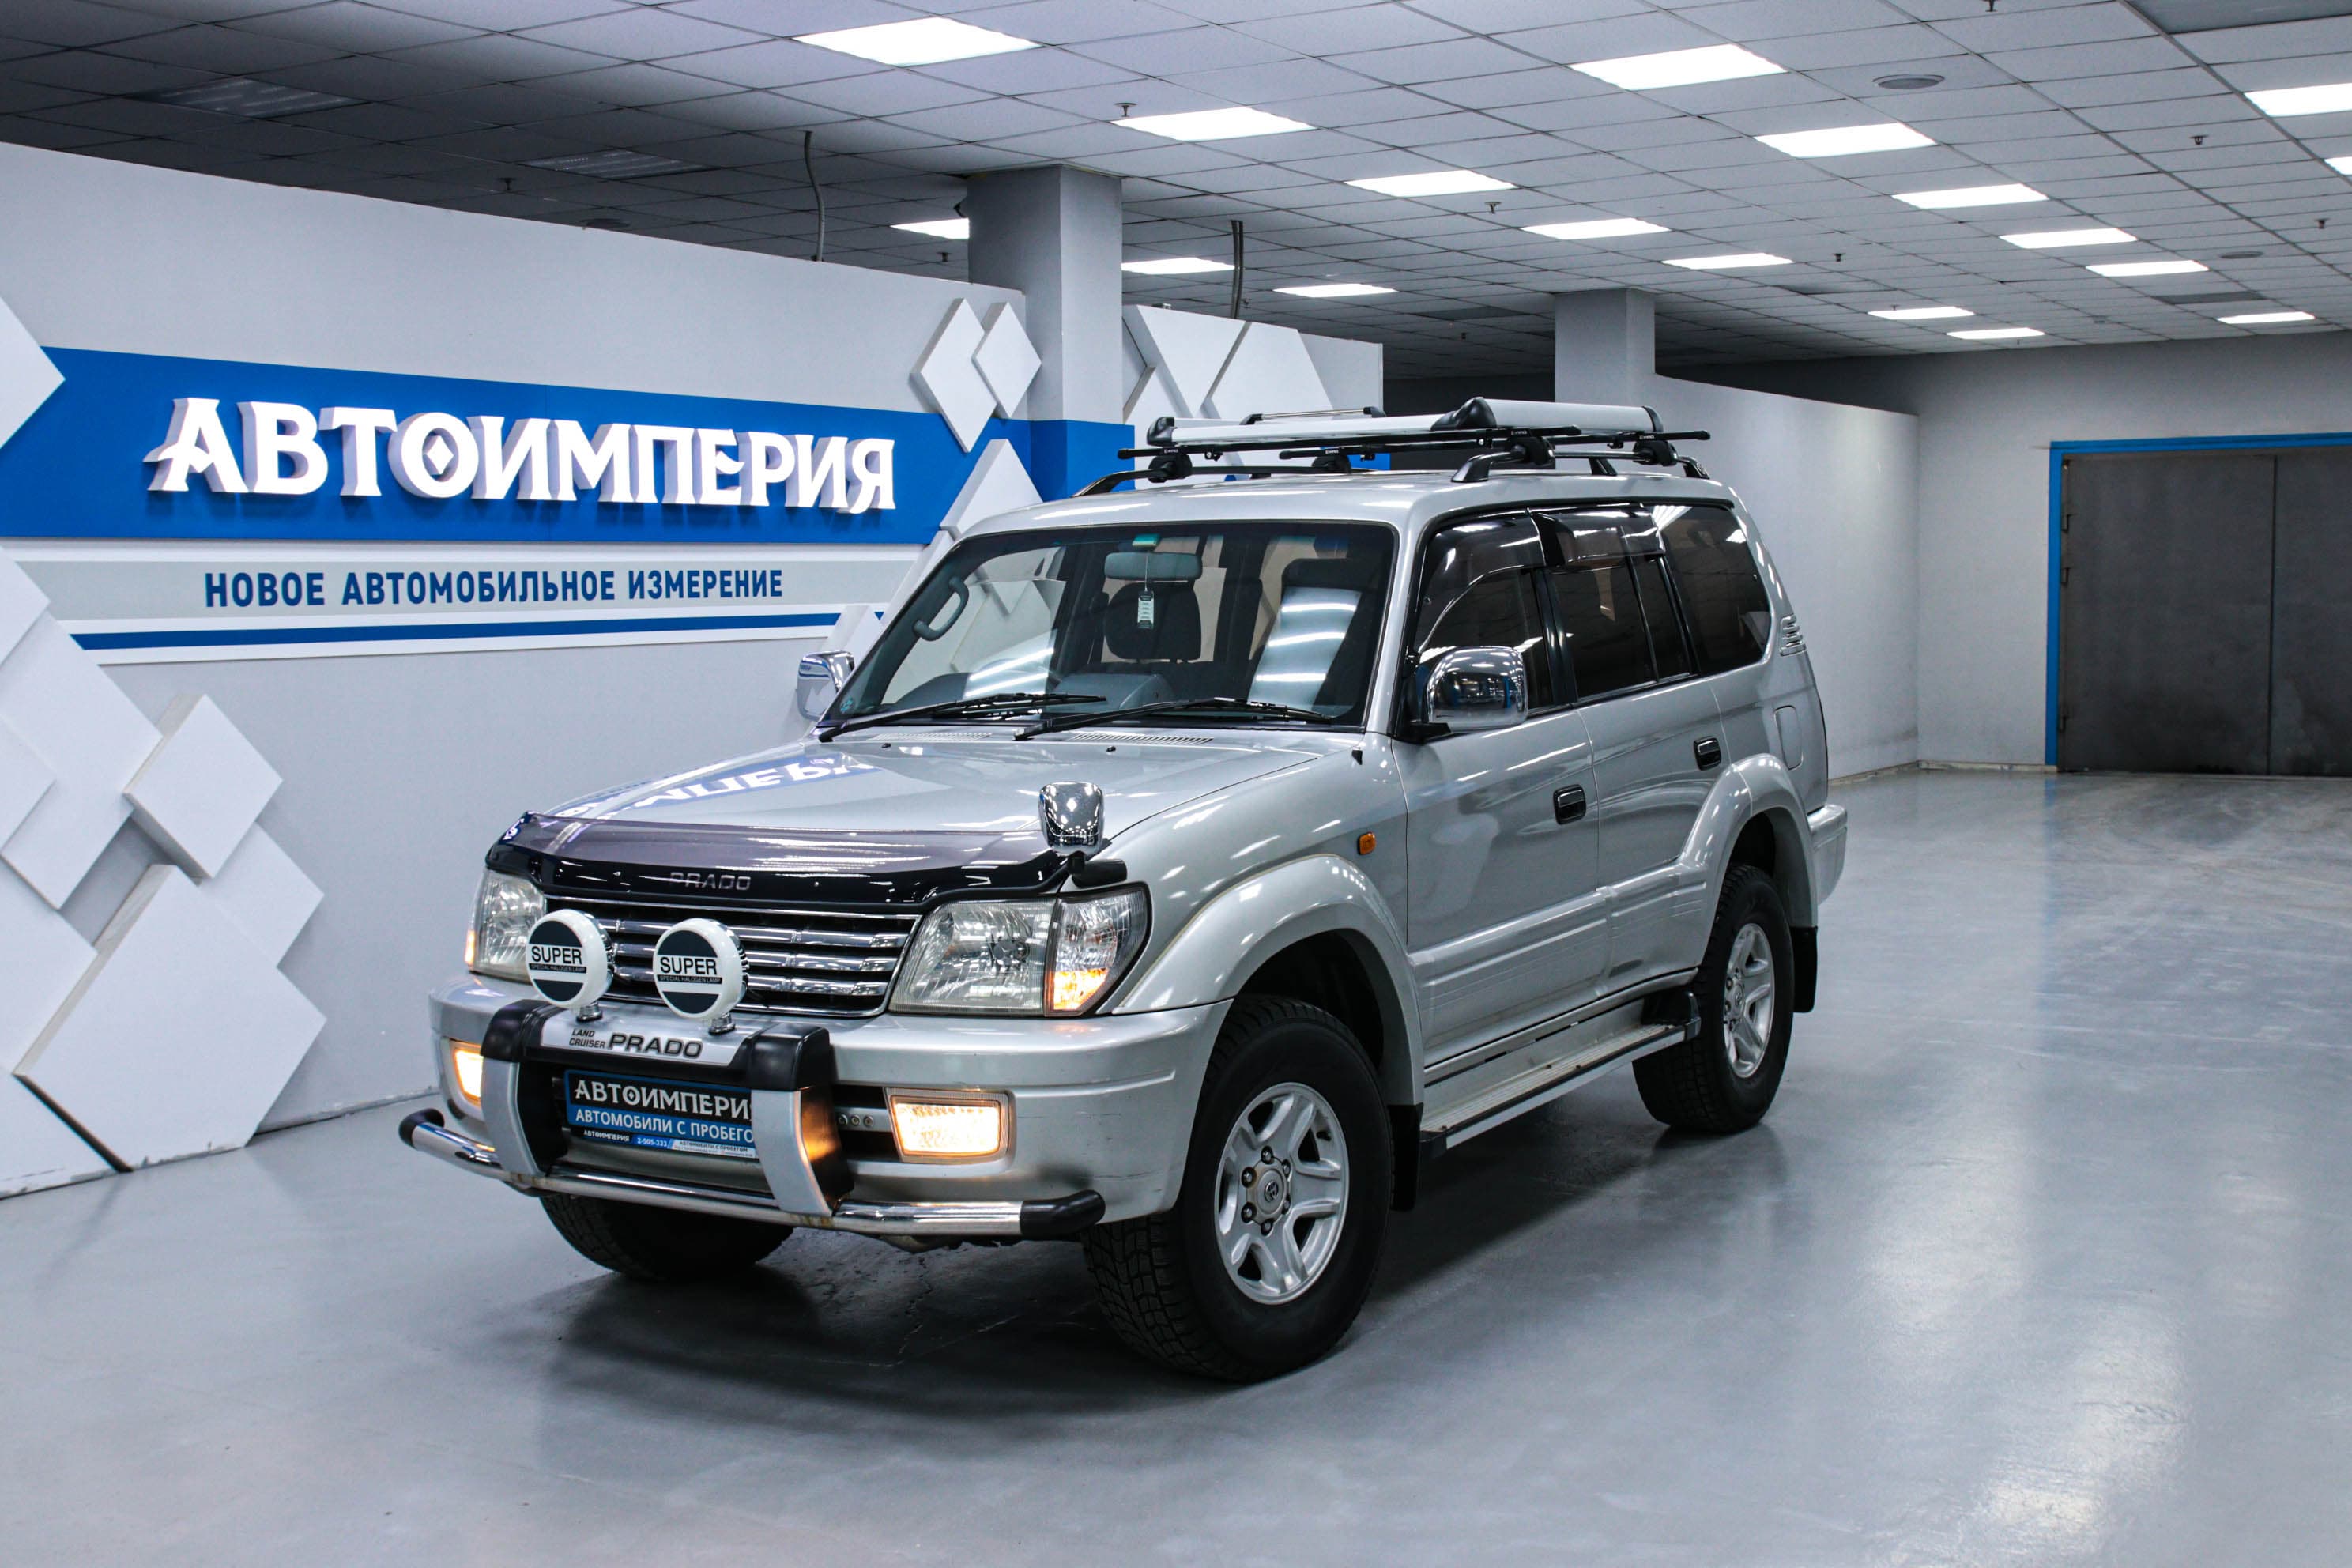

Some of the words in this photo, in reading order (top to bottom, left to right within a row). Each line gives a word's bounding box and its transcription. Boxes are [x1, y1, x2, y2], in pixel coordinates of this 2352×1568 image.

[145, 397, 895, 513] АВТОИМПЕРИЯ
[205, 571, 325, 608] НОВОЕ
[342, 570, 616, 605] АВТОМОБИЛЬНОЕ
[628, 568, 782, 600] ИЗМЕРЕНИЕ
[669, 872, 751, 890] PRADO
[531, 946, 582, 964] SUPER
[660, 956, 718, 974] SUPER
[569, 1038, 606, 1049] CRUISER
[608, 1033, 703, 1059] PRADO
[575, 1080, 752, 1122] АВТОИМПЕРИ
[575, 1109, 673, 1133] АВТОМОБИЛИ
[583, 1129, 629, 1142] АВТОИМПЕРИЯ
